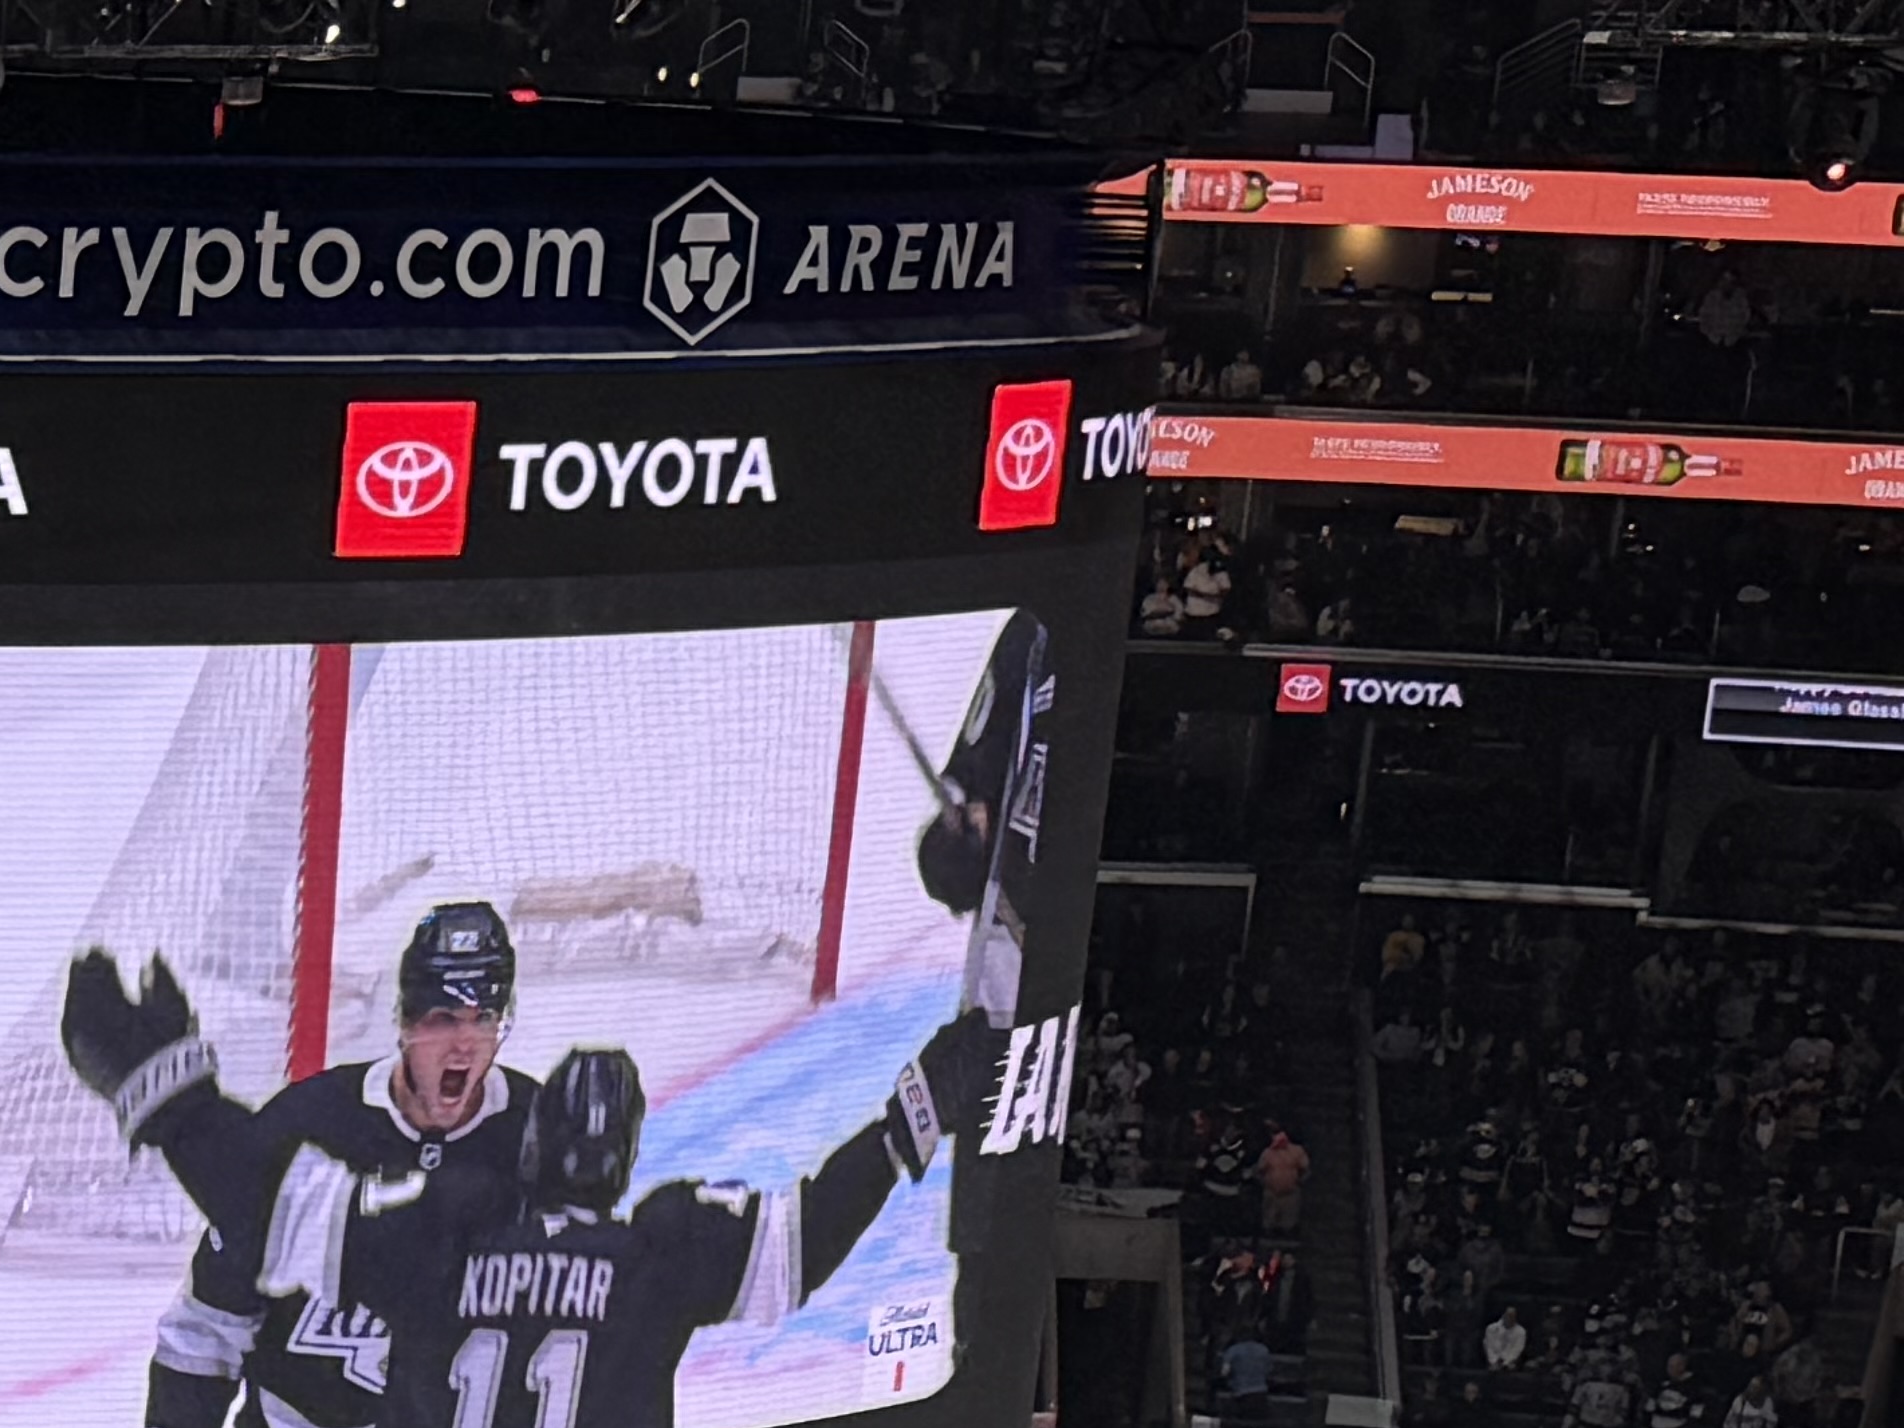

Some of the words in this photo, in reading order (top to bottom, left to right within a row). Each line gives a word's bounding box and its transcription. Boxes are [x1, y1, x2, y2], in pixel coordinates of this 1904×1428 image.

[1426, 172, 1535, 201] JAMESON
[783, 220, 1016, 295] ARENA
[499, 435, 778, 511] TOYOTA
[1845, 449, 1904, 476] JAME
[1339, 677, 1464, 708] TOYOTA
[458, 1252, 616, 1322] KOPITAR
[867, 1322, 938, 1358] ULTRA
